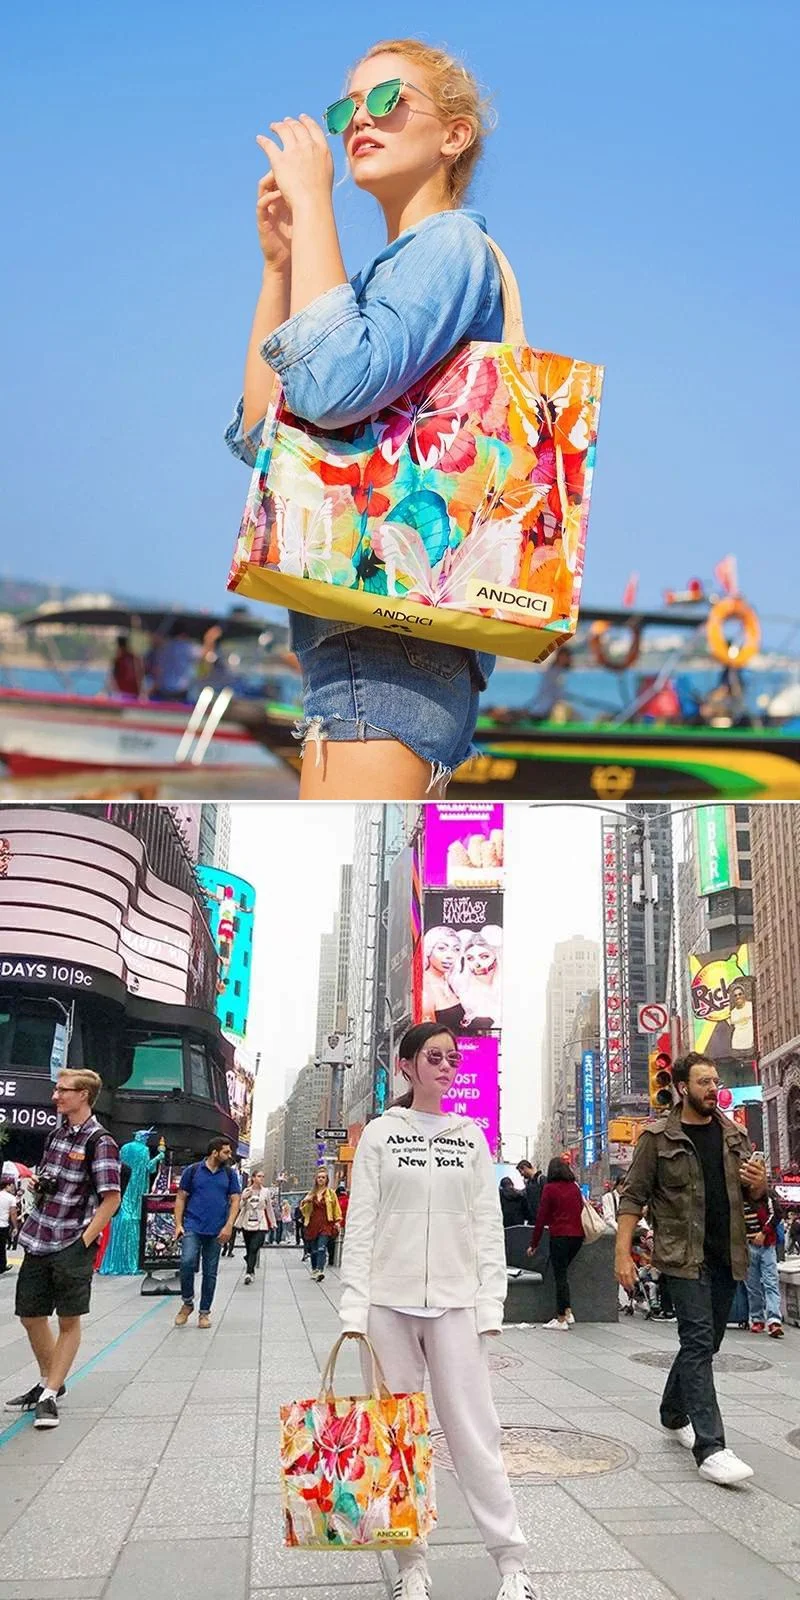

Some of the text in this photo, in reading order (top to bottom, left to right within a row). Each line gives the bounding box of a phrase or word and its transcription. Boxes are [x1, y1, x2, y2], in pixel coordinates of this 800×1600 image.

[476, 587, 547, 612] ANDCICI
[373, 607, 433, 626] ANDCICI
[443, 901, 488, 913] FANTASY
[0, 962, 47, 978] DAYS
[455, 1074, 477, 1085] OST
[455, 1103, 467, 1113] IN
[398, 1156, 464, 1168] New York
